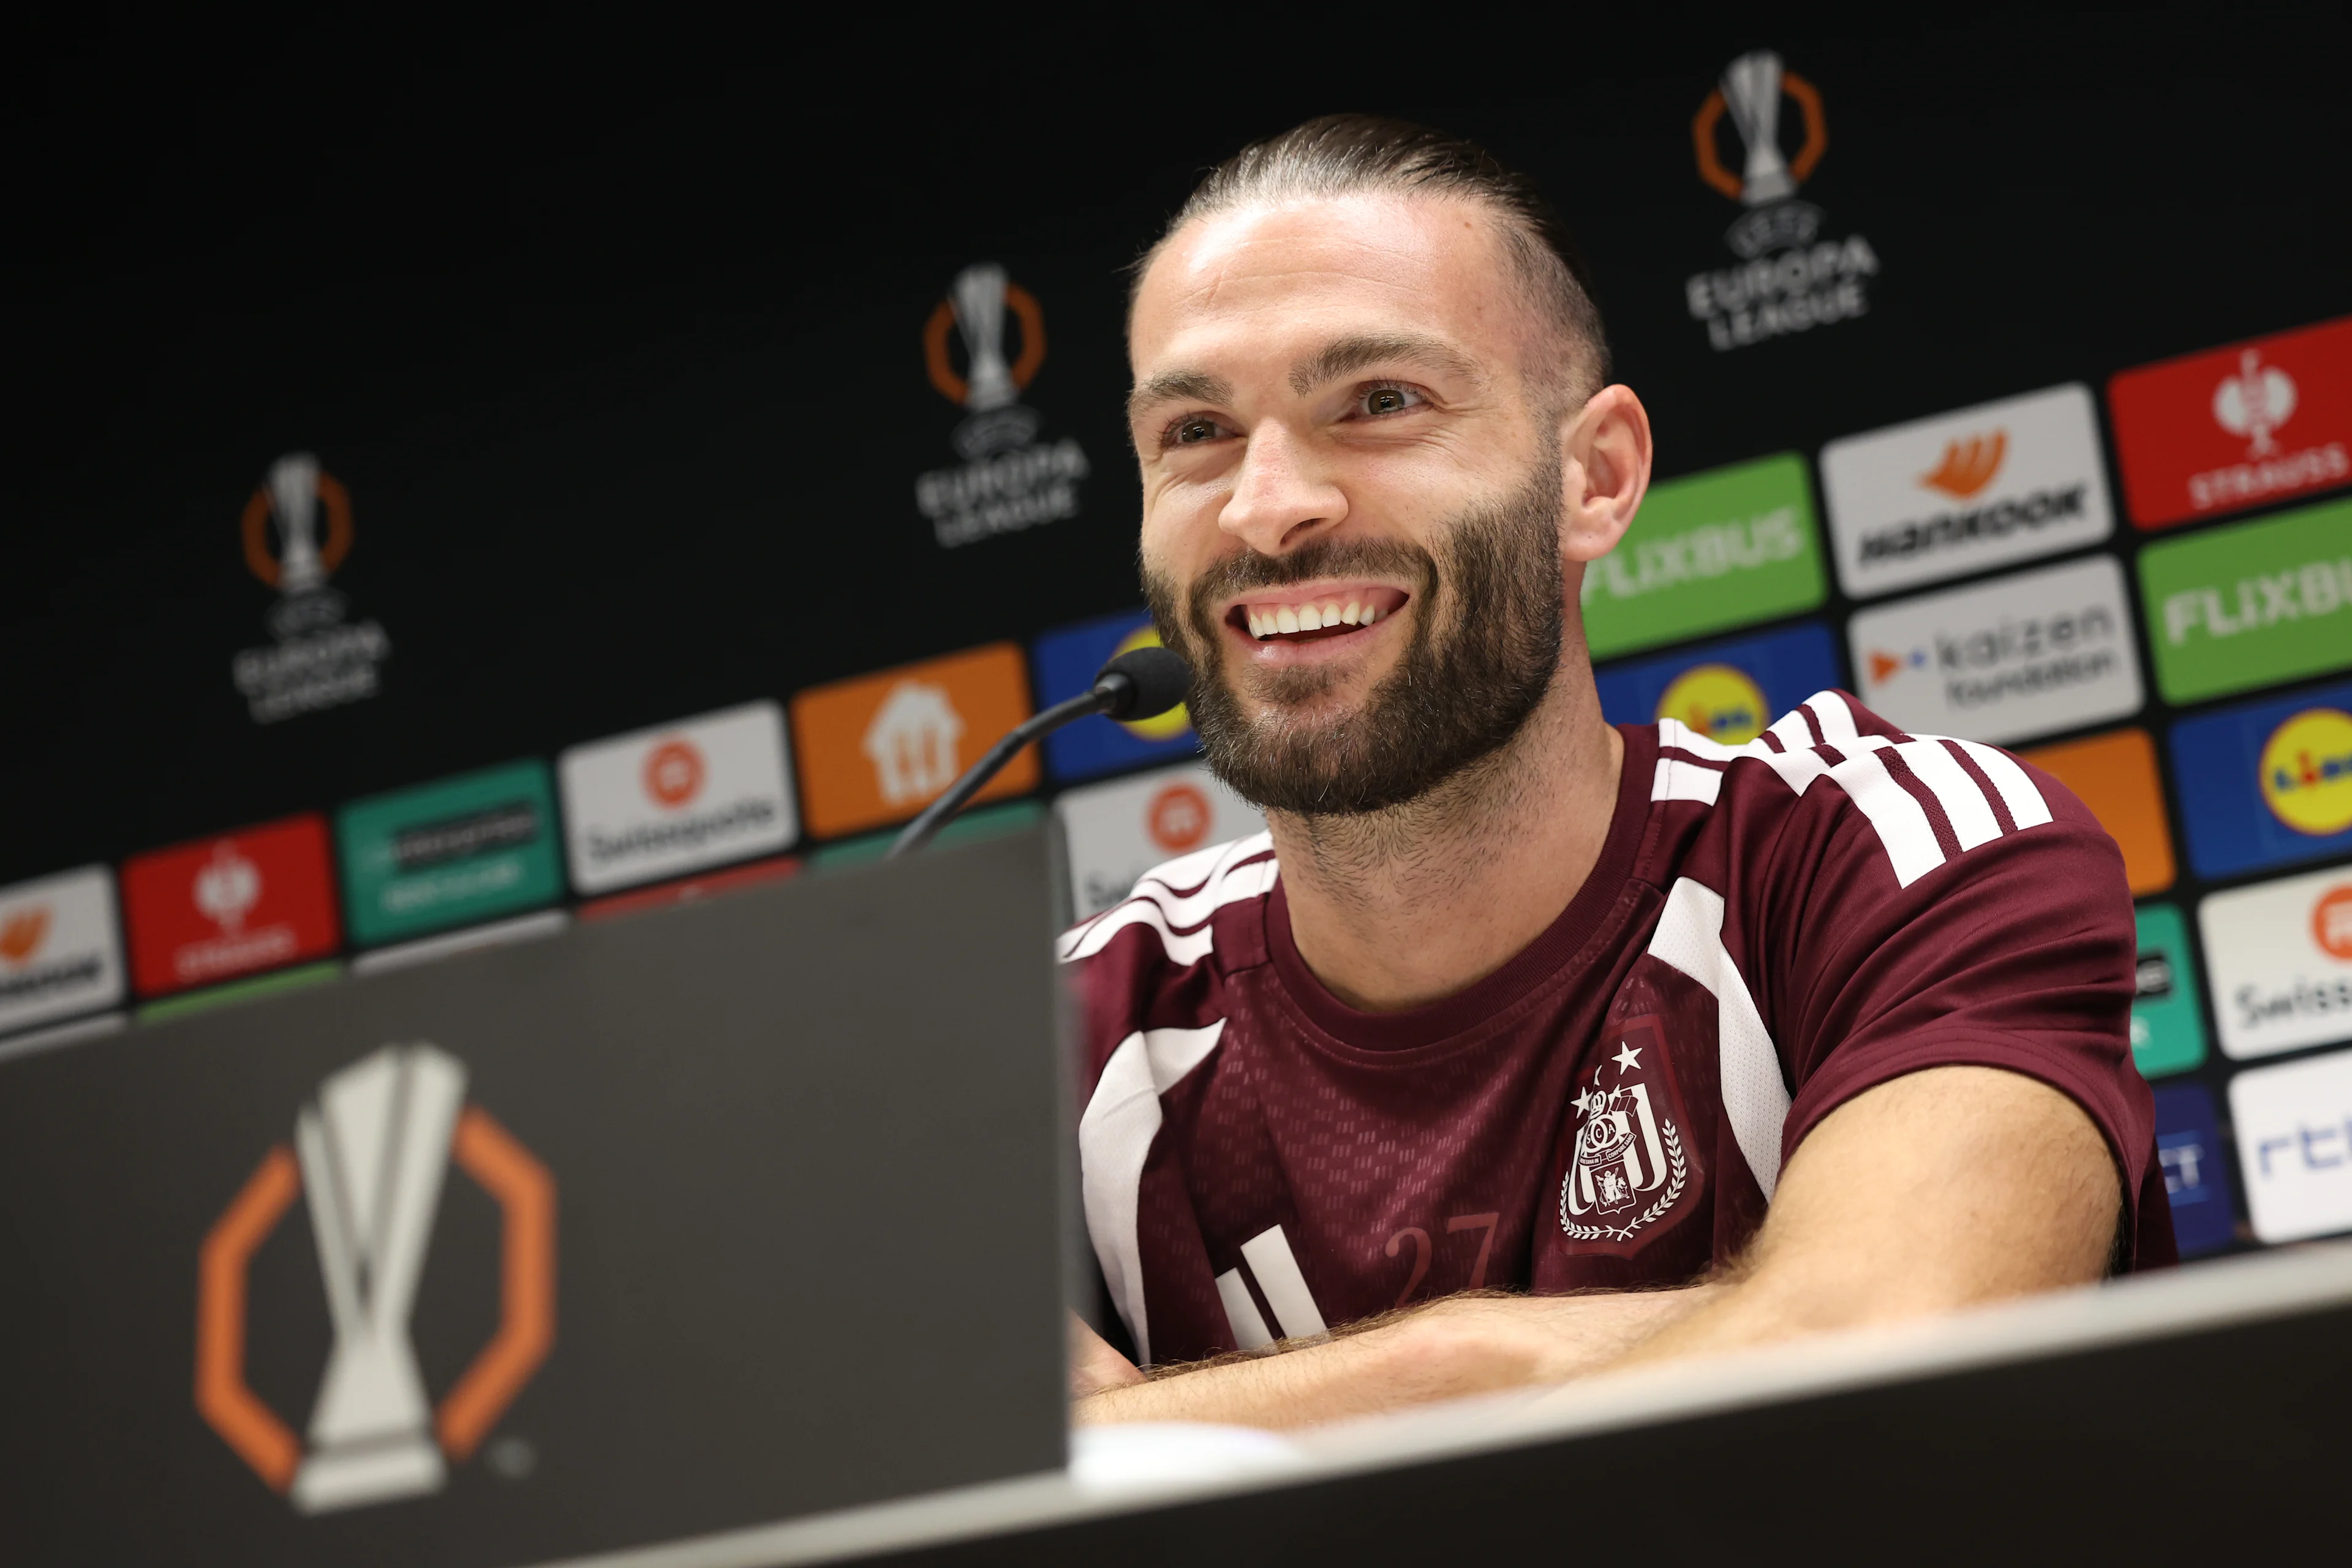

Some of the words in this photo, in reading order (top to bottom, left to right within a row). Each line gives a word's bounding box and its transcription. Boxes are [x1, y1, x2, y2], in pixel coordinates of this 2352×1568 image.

[1686, 234, 1879, 318] EUROPA
[1709, 285, 1866, 350] LEAGUE
[916, 440, 1088, 516] EUROPA
[2190, 443, 2348, 508] STRAUSS
[935, 486, 1077, 546] LEAGUE
[1937, 608, 2113, 668] kaizen
[1947, 652, 2114, 709] foundation
[1608, 1144, 1626, 1158] CORPORE
[1624, 1134, 1634, 1146] SANO
[1385, 1212, 1499, 1309] 27
